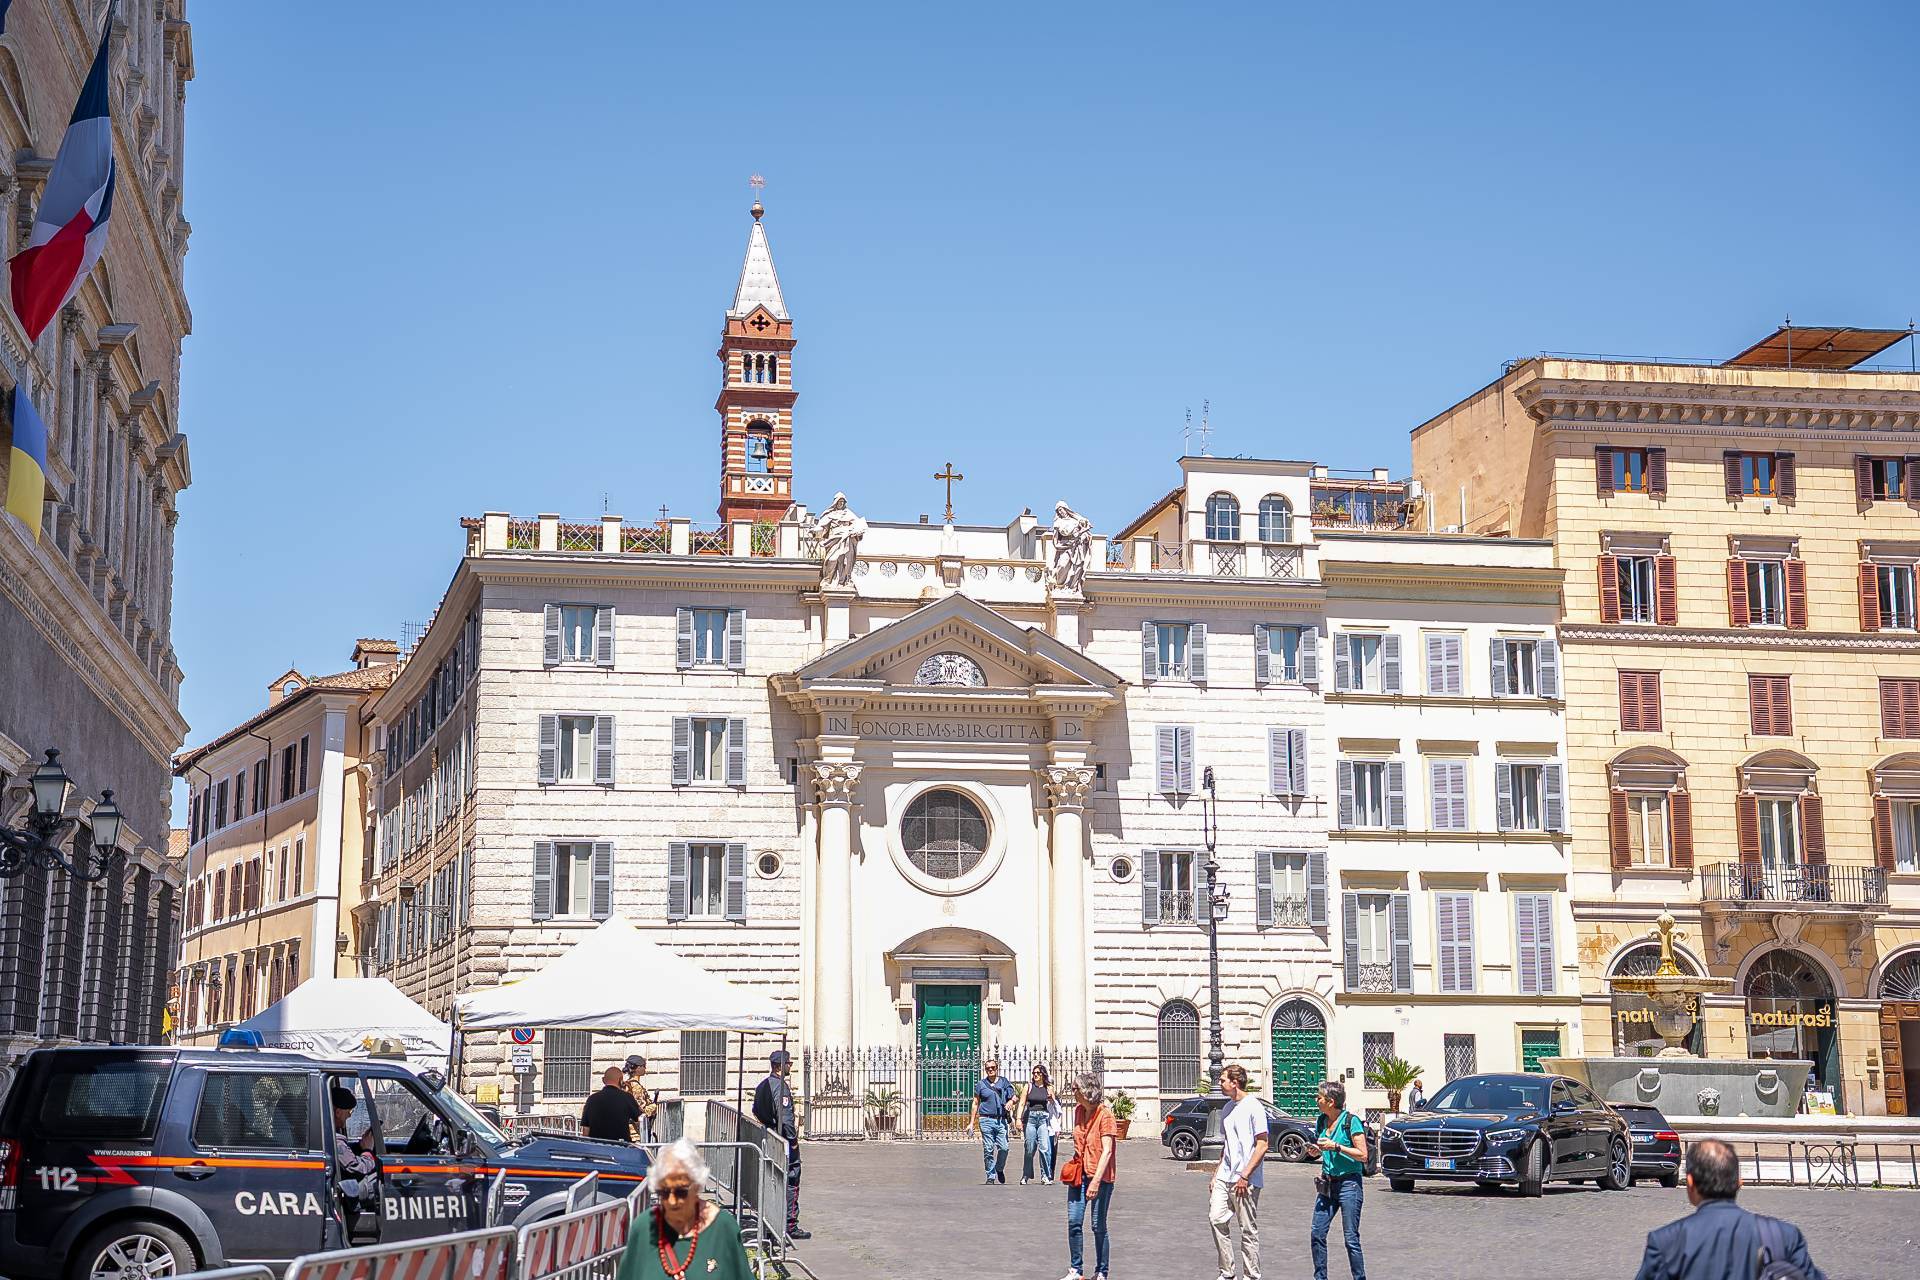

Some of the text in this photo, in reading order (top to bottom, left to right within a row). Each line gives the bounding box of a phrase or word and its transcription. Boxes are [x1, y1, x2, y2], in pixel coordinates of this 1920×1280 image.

[828, 717, 848, 732] IN
[957, 723, 1051, 740] BIRGITTAE
[35, 1165, 80, 1192] 112
[234, 1191, 324, 1216] CARA
[384, 1195, 468, 1221] BINIERI
